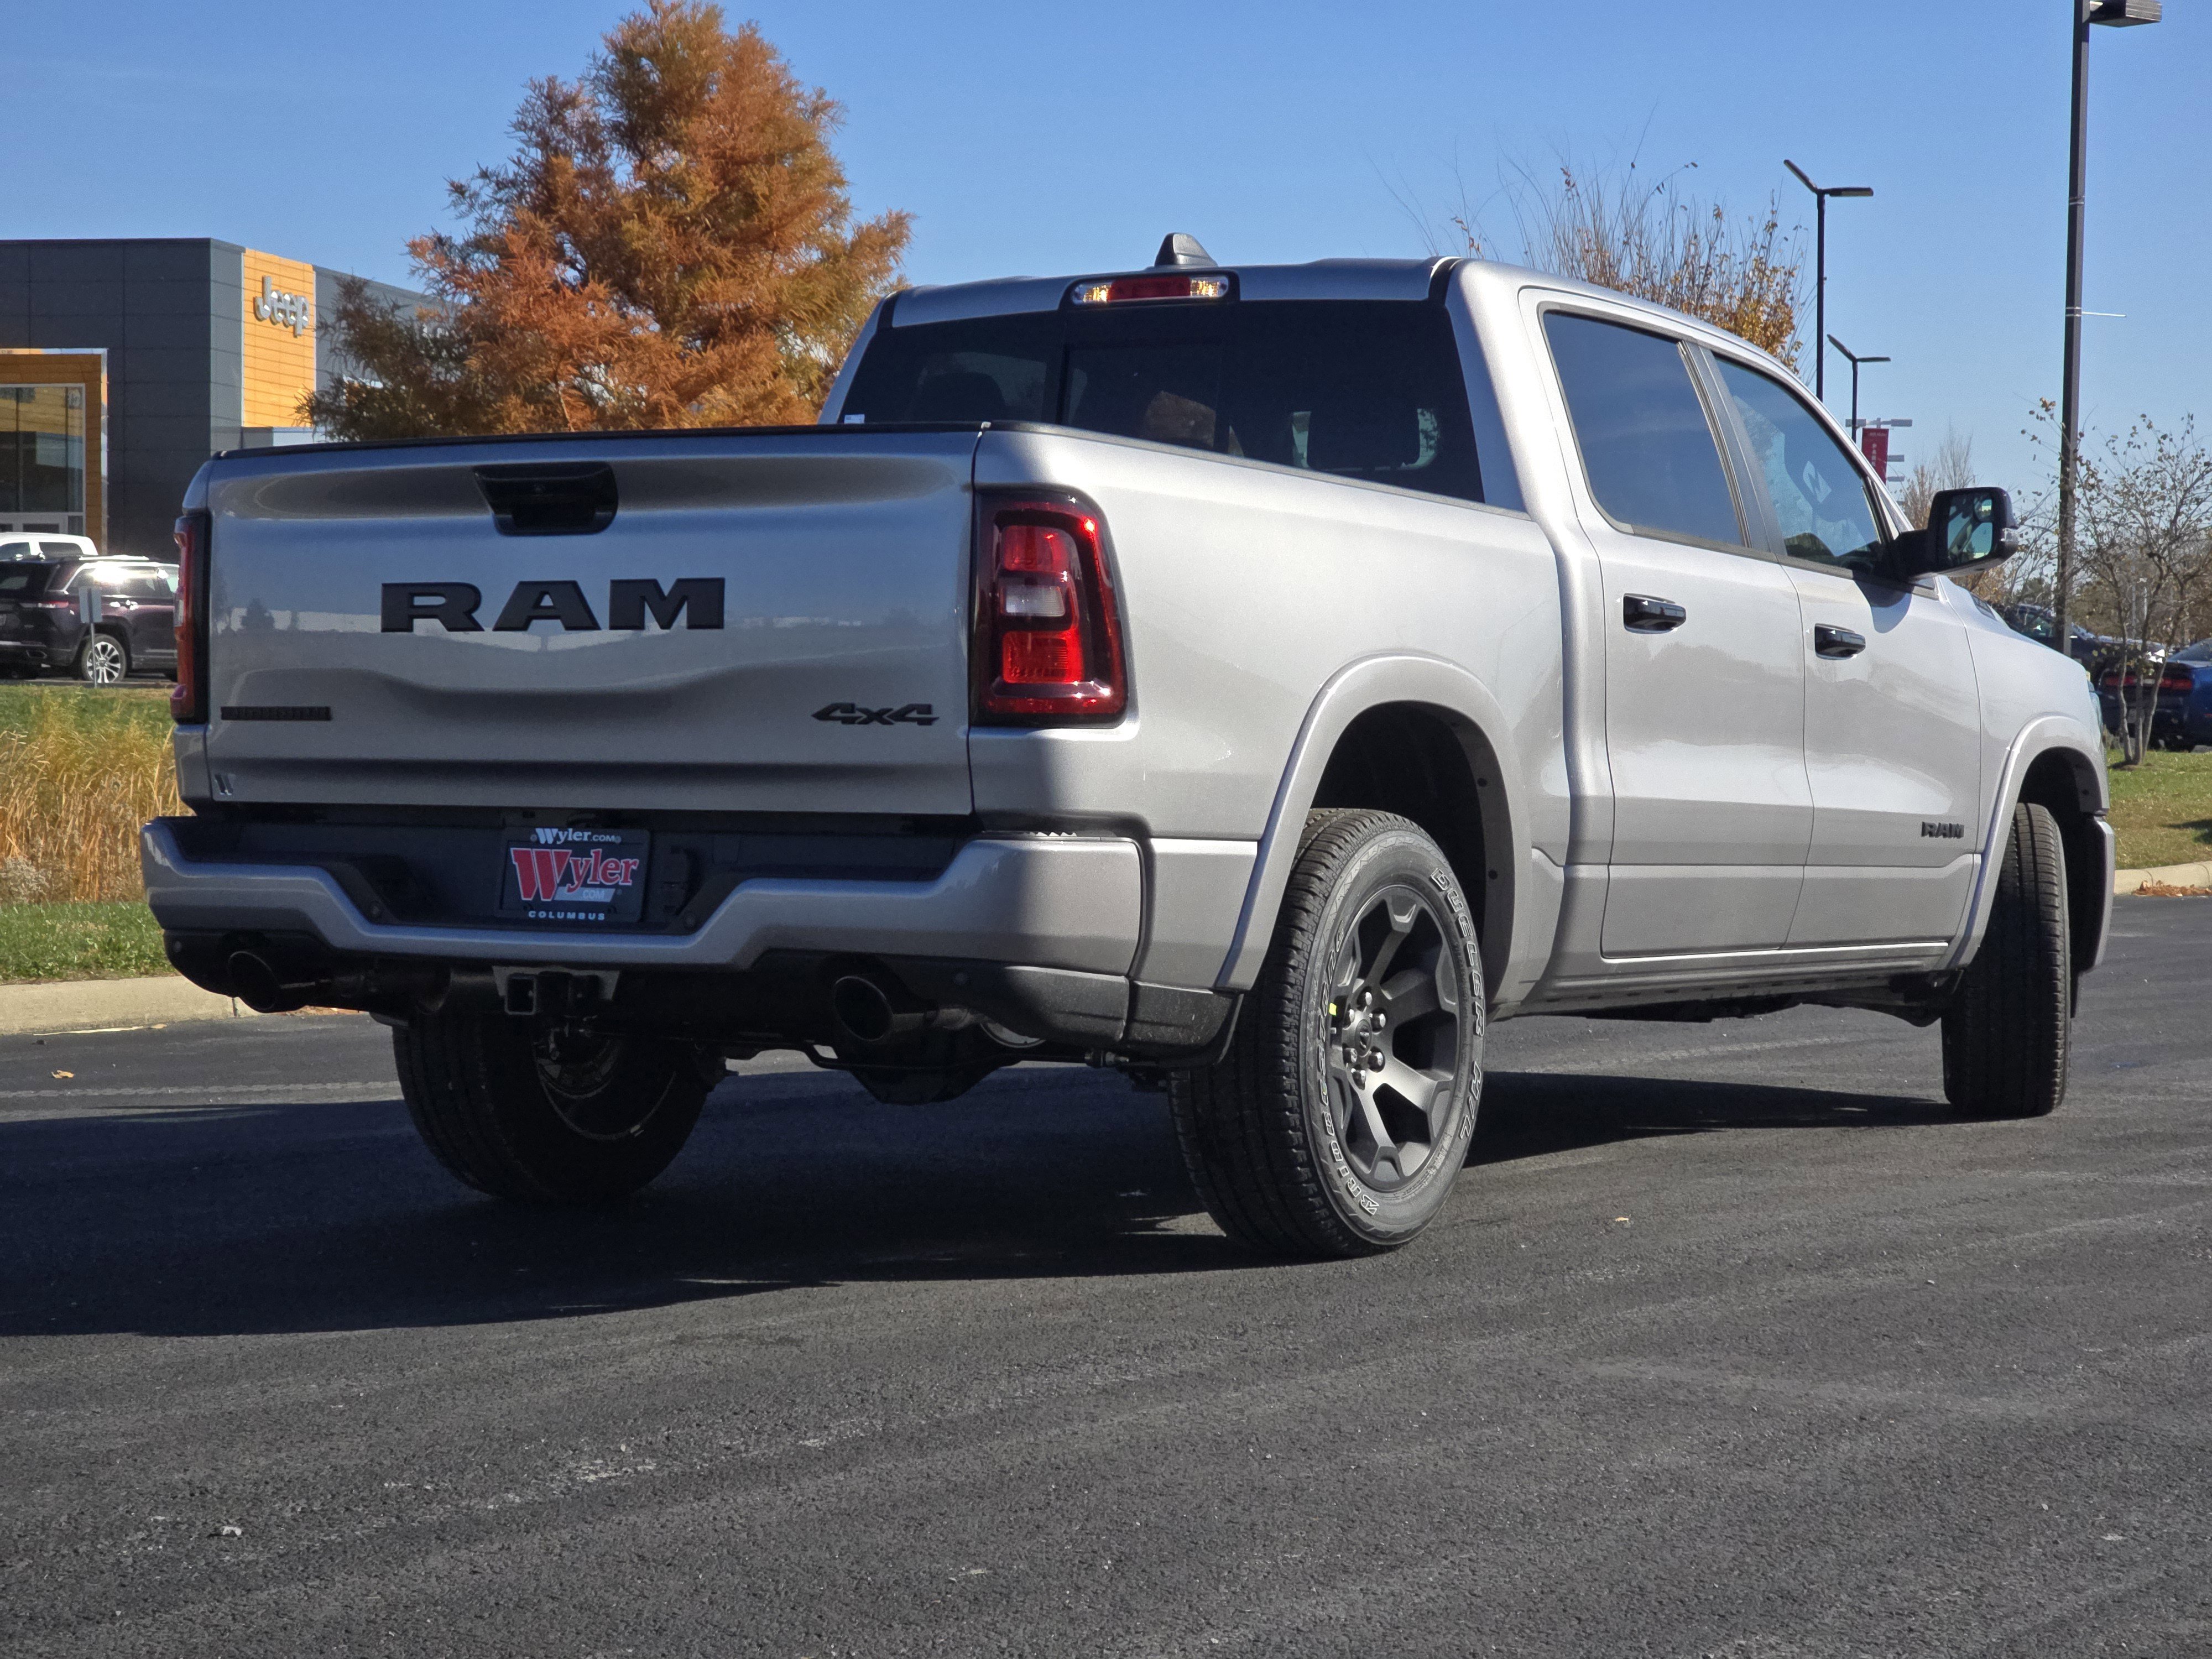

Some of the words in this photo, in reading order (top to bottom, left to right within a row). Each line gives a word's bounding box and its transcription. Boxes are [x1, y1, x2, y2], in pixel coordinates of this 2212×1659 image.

[254, 275, 310, 337] Jeep
[381, 577, 726, 633] RAM
[1922, 822, 1964, 839] RAM
[510, 847, 639, 901] Wyler
[528, 910, 606, 921] COLUMBUS
[1431, 867, 1484, 1037] DUELER
